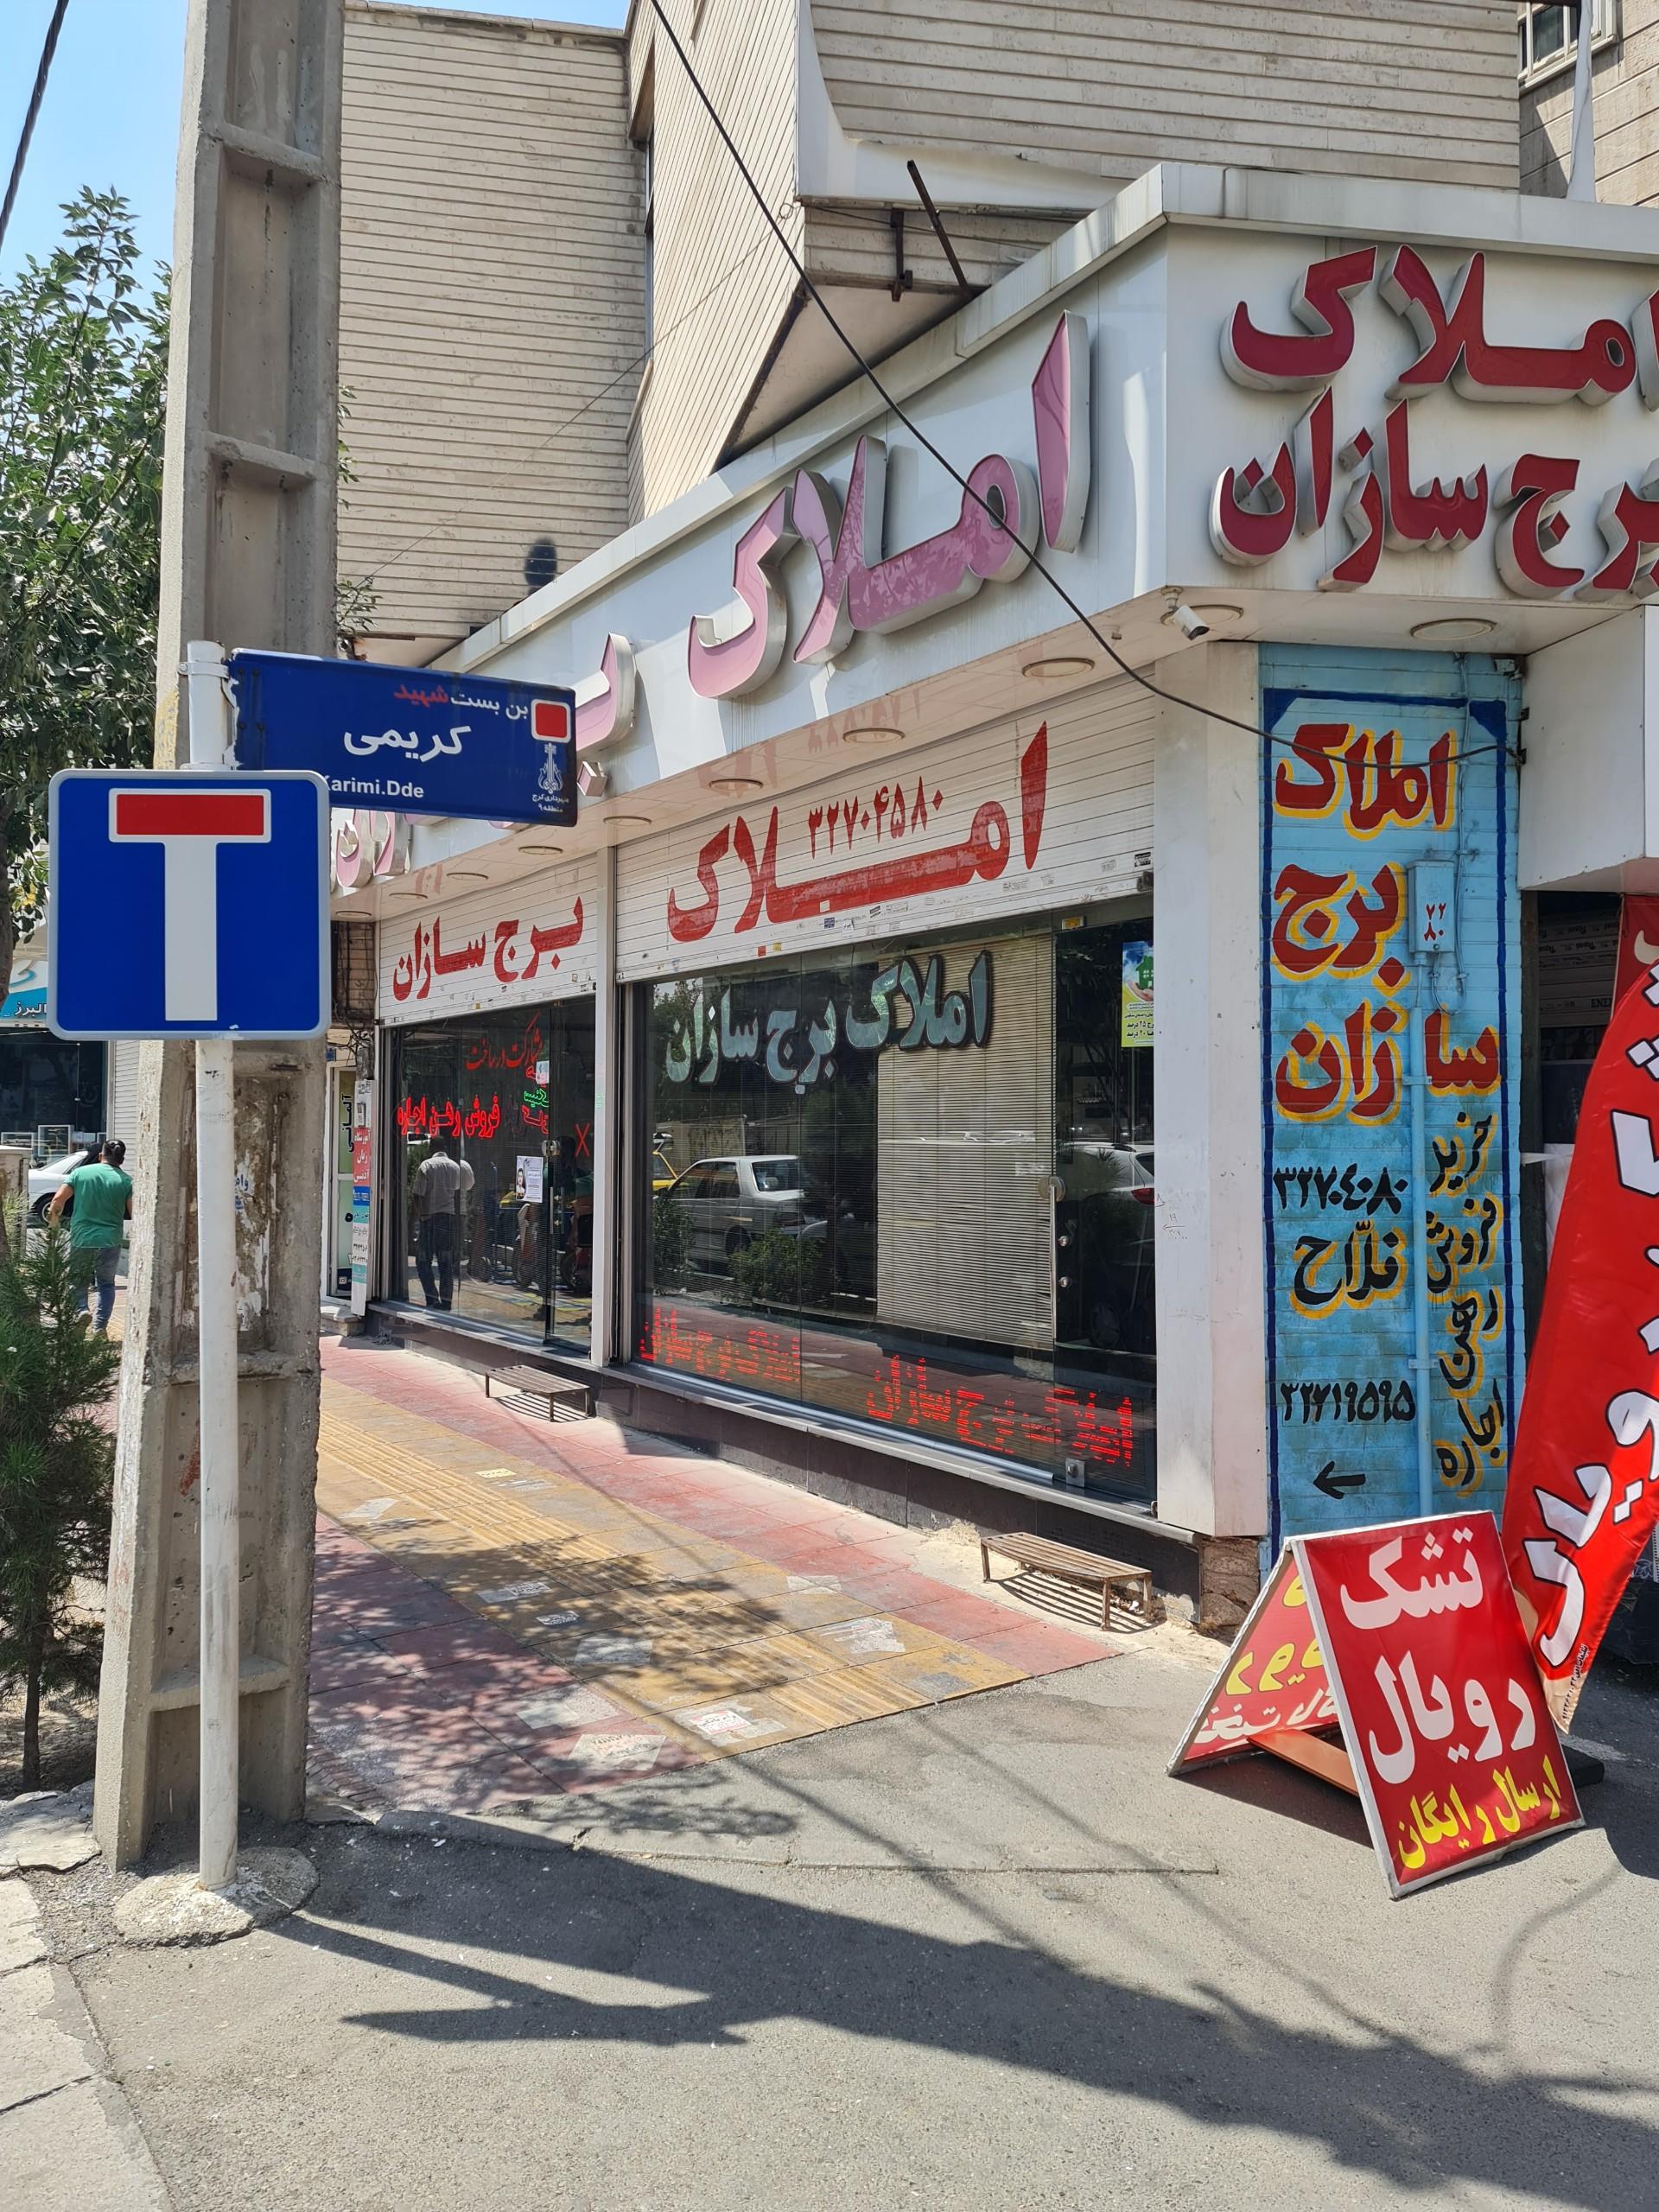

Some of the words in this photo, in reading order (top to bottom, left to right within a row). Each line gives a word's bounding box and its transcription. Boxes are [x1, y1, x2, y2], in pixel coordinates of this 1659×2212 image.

[1221, 245, 1659, 406] ملاک
[689, 309, 1090, 700] املاک
[1211, 386, 1488, 590] سازان
[394, 685, 449, 707] شهید
[450, 692, 500, 711] بست
[505, 704, 529, 720] بن
[344, 726, 472, 762] کریمی
[1273, 723, 1457, 842] املاک
[668, 720, 1048, 944] املاک
[808, 776, 944, 859] ۳۲۷۰۴۵۸۰
[393, 916, 486, 1001] سازان
[493, 895, 585, 984] برج
[1273, 861, 1410, 997] برج
[15, 1001, 48, 1017] البرز
[666, 988, 760, 1086] سازان
[765, 1000, 836, 1085] برج
[845, 950, 994, 1052] املاک
[397, 1095, 426, 1137] اجاره
[429, 1098, 461, 1138] رهن
[464, 1094, 500, 1138] فروش
[1430, 1111, 1498, 1198] خرید
[1426, 1192, 1504, 1302] فروش
[1438, 1286, 1504, 1399] رهن
[1433, 1378, 1507, 1498] اجاره
[1340, 1527, 1484, 1630] تشک
[1369, 1650, 1536, 1784] رویال
[1398, 1783, 1497, 1869] رایگان
[1492, 1754, 1562, 1831] ارسال
